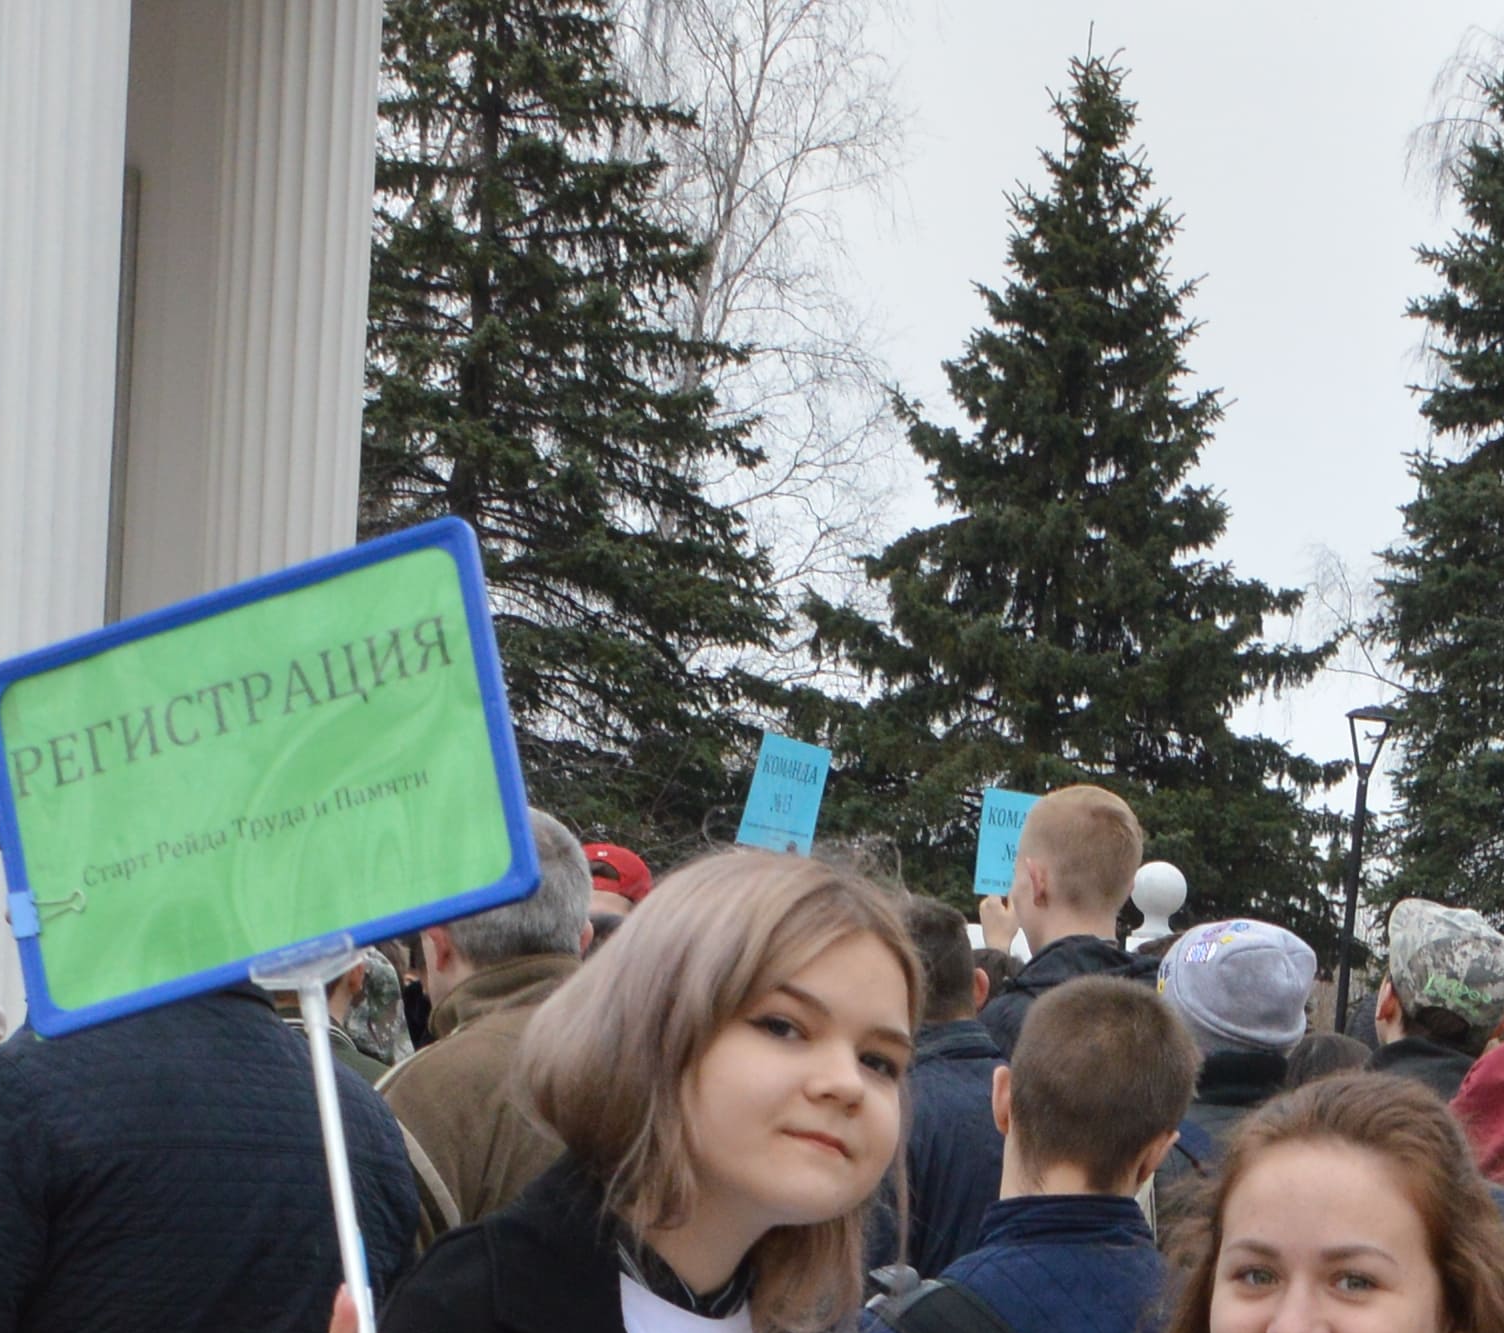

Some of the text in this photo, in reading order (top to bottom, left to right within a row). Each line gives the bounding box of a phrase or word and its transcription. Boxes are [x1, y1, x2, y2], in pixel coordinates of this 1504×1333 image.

[10, 616, 455, 798] РЕГИСТРАЦИЯ
[762, 754, 819, 785] КОМАНДА
[82, 769, 430, 887] Старт Рейда Труда и Памяти
[988, 806, 1027, 829] КОМА
